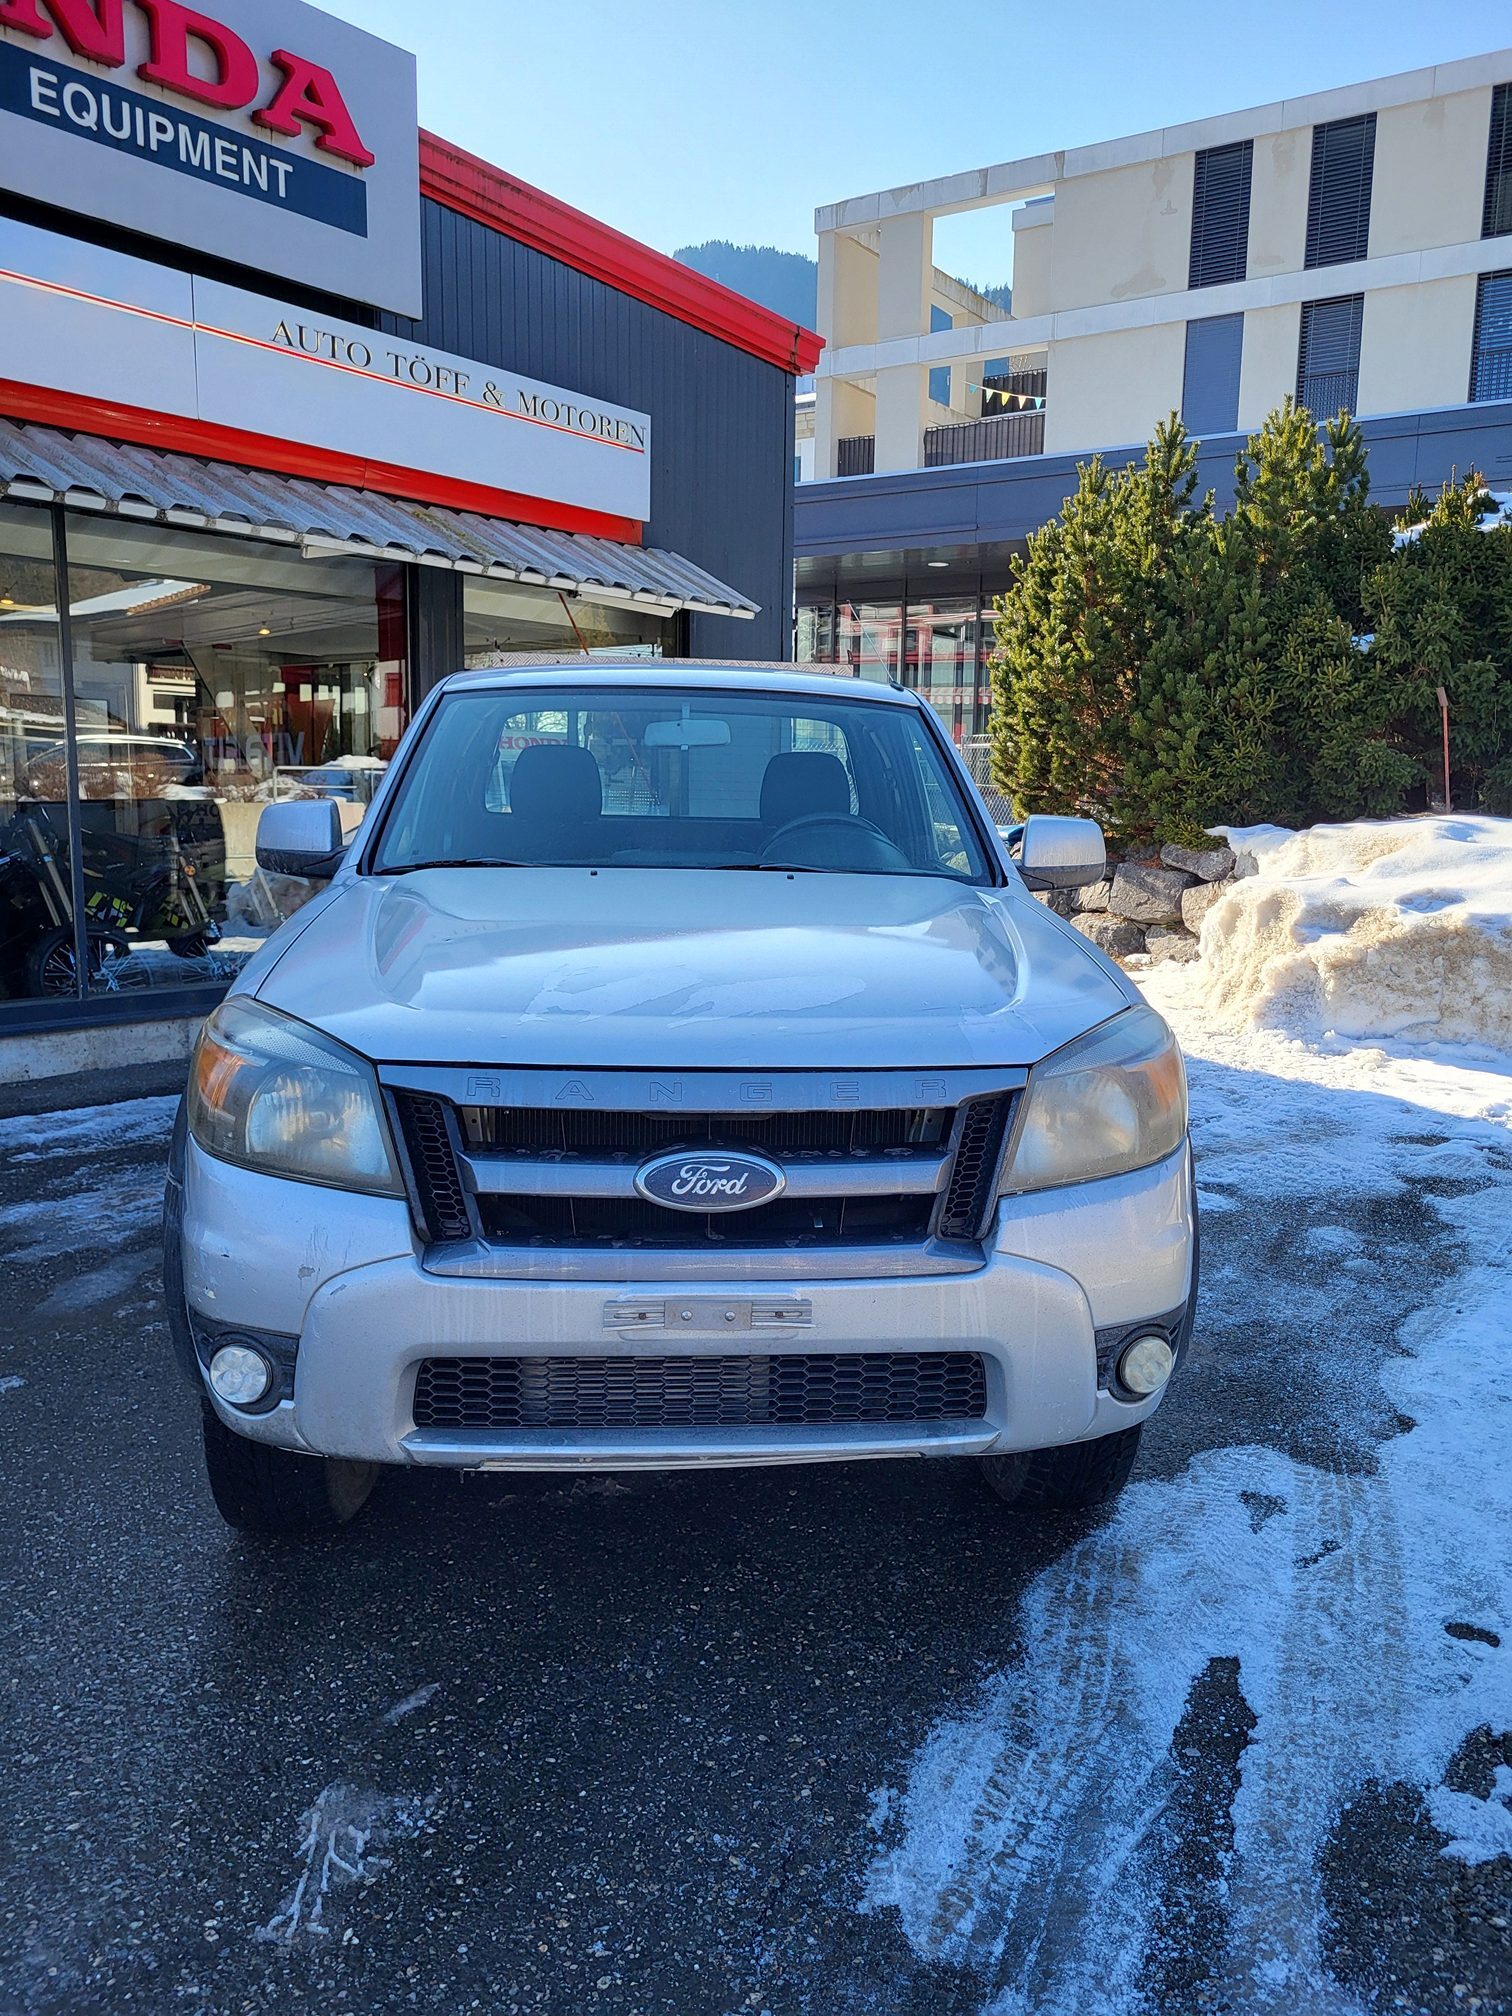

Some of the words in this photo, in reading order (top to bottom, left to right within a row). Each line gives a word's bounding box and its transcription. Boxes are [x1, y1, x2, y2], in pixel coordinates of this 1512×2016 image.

[29, 66, 294, 199] EQUIPMENT
[271, 319, 372, 368] AUTO
[386, 351, 471, 397] TÖFF
[482, 379, 506, 409] &
[516, 389, 647, 447] MOTOREN
[466, 1076, 948, 1101] RANGER
[671, 1163, 749, 1197] Ford
